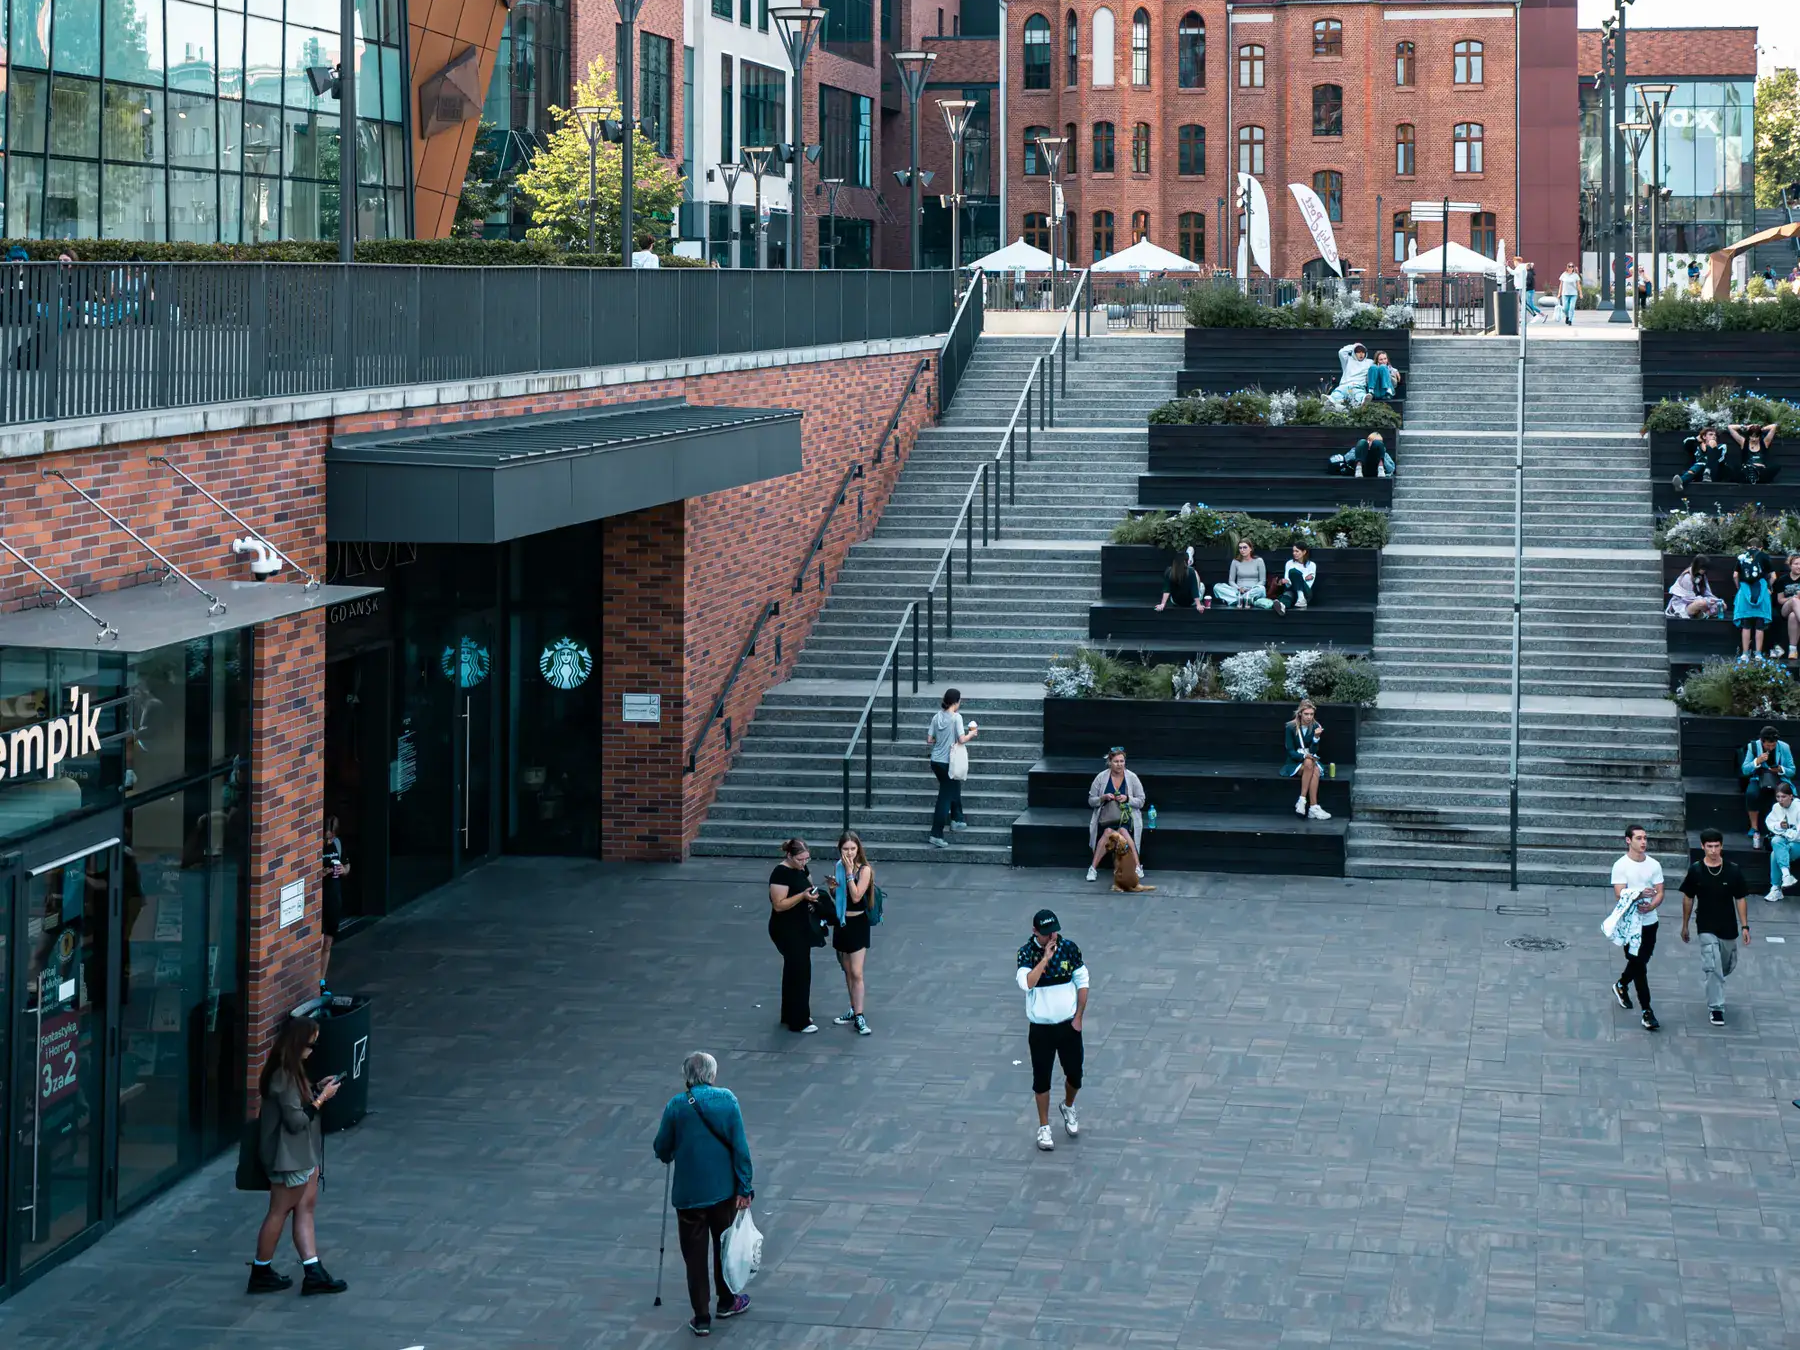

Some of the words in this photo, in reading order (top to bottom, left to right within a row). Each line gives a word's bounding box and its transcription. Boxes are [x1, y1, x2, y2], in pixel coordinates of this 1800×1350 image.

[41, 1021, 77, 1047] Fantastyka
[48, 1040, 71, 1058] Horror
[42, 1063, 52, 1097] 3
[52, 1075, 64, 1093] za
[64, 1051, 76, 1085] 2
